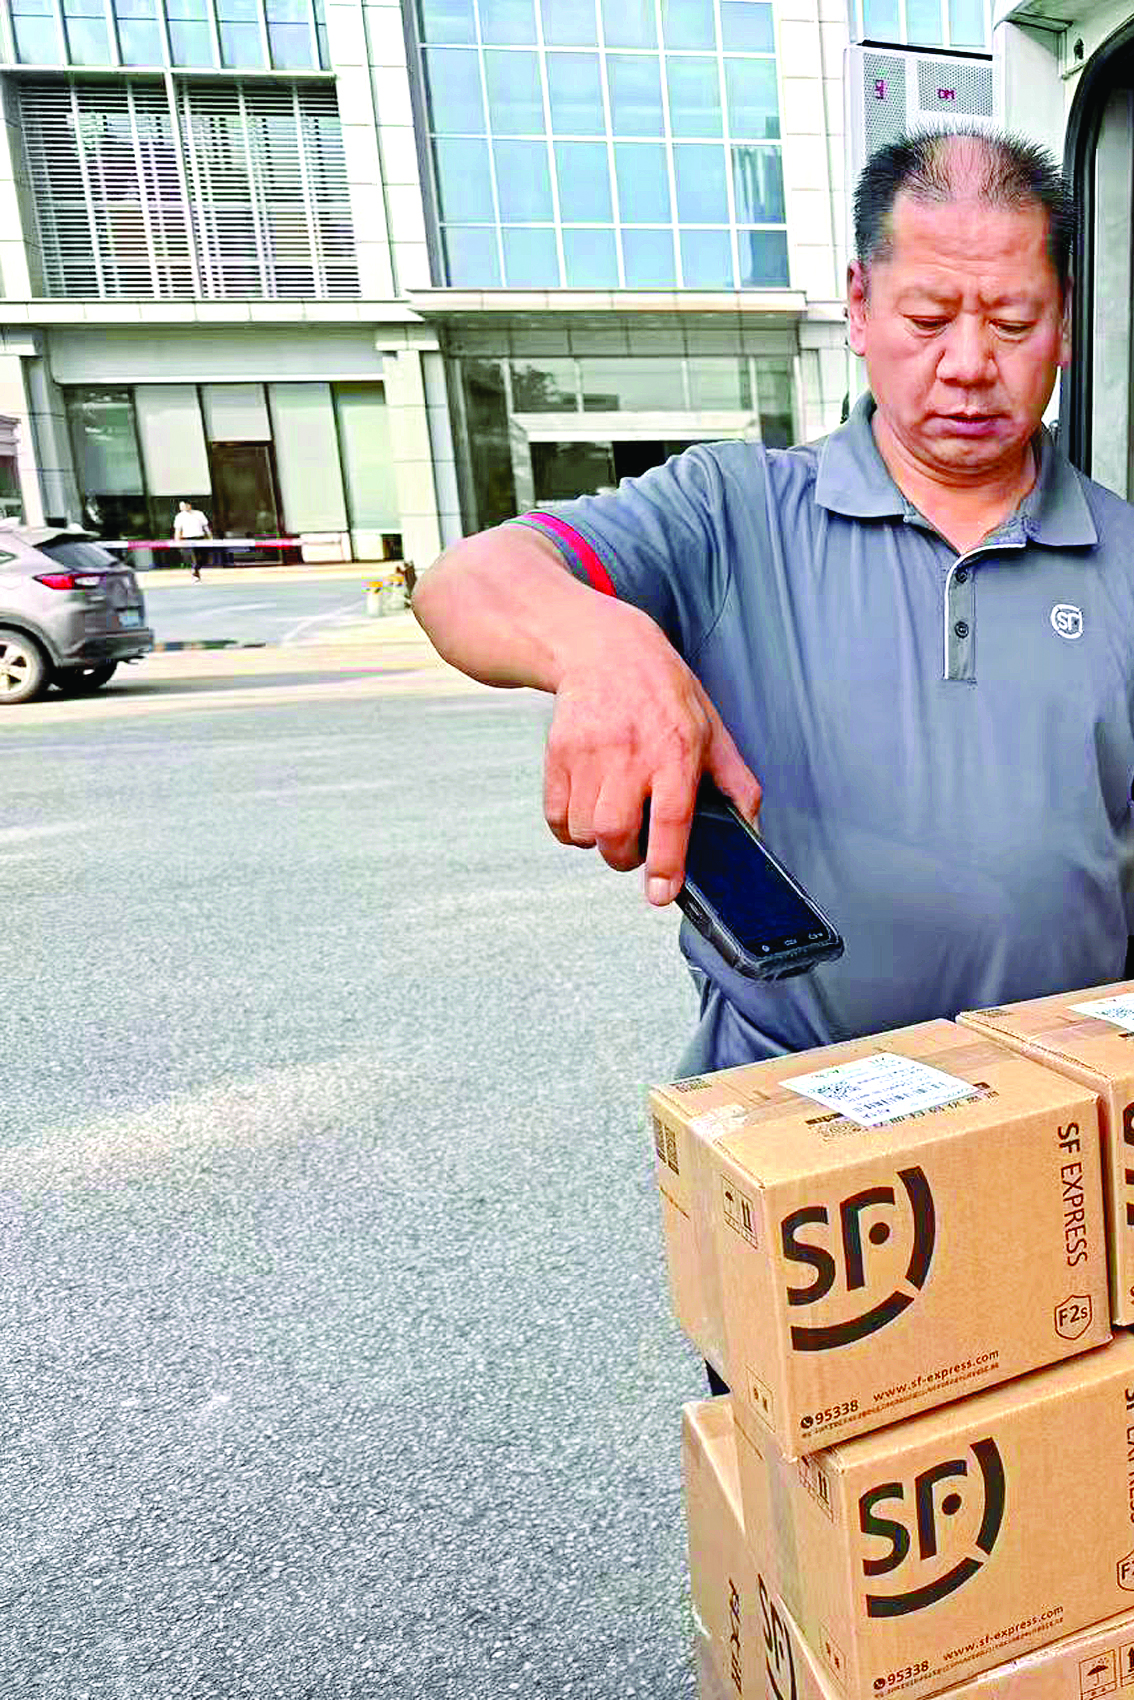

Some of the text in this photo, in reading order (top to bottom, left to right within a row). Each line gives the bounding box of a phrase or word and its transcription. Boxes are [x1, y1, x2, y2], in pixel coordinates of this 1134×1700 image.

[1058, 1123, 1087, 1267] SF EXPRESS
[1059, 1305, 1088, 1327] F2s
[815, 1399, 859, 1424] 95338
[873, 1350, 999, 1401] www.sf-express.com
[887, 1660, 929, 1686] 95338
[943, 1605, 1064, 1661] www.sf-express.com
